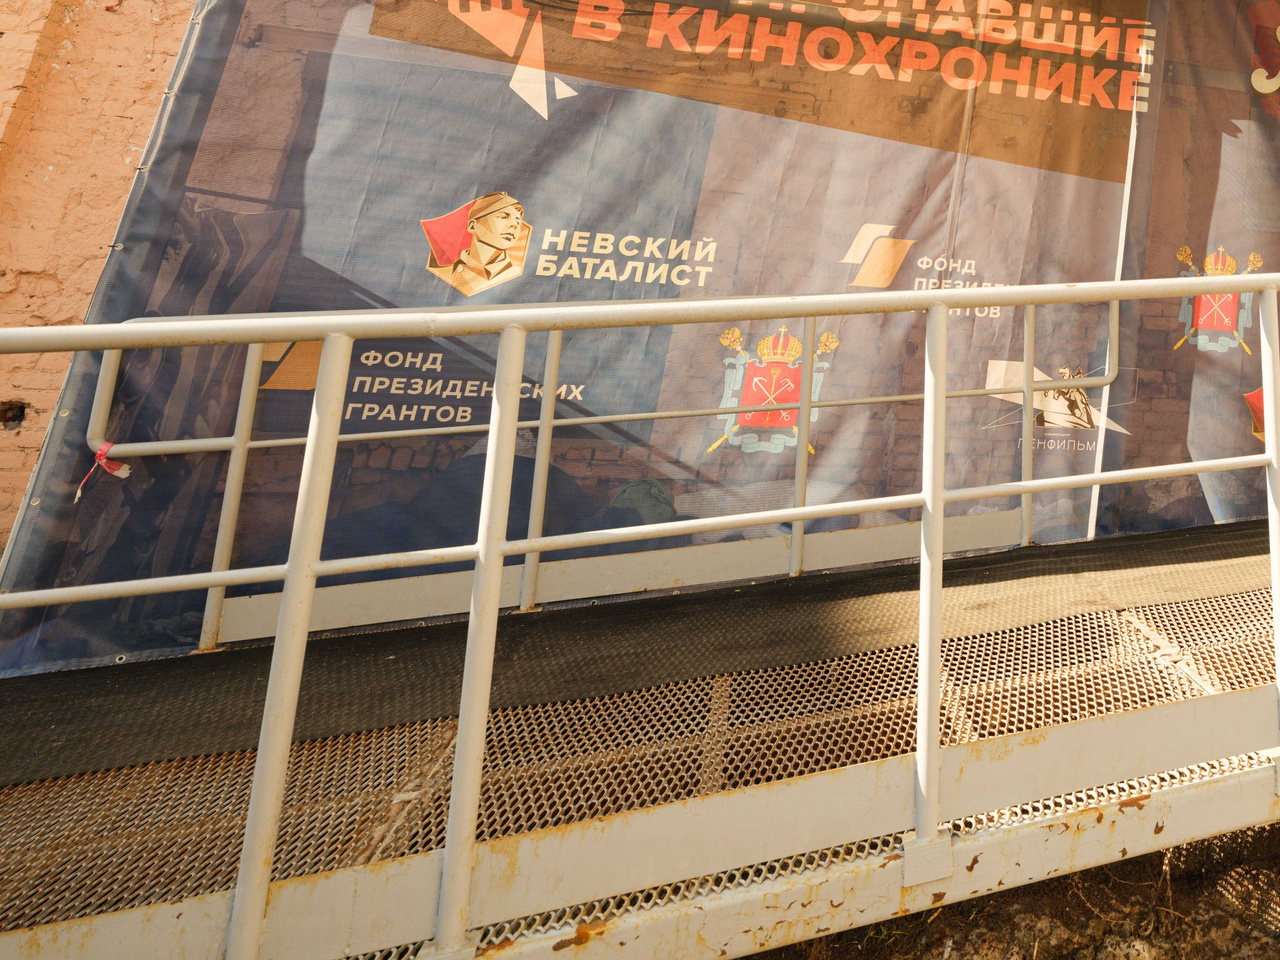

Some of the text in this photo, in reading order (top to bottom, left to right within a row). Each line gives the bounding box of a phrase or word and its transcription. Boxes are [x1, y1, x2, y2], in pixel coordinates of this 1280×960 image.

[646, 1, 1151, 112] КИНОХРОНИКЕ
[541, 228, 717, 263] НЕВСКИЙ
[535, 254, 713, 287] БАТАЛИСТ
[916, 256, 977, 276] ФОНД
[360, 350, 444, 372] ФОНД
[352, 376, 586, 401] ПРЕЗИДЕНСКИХ
[344, 403, 473, 423] ГРАНТОВ
